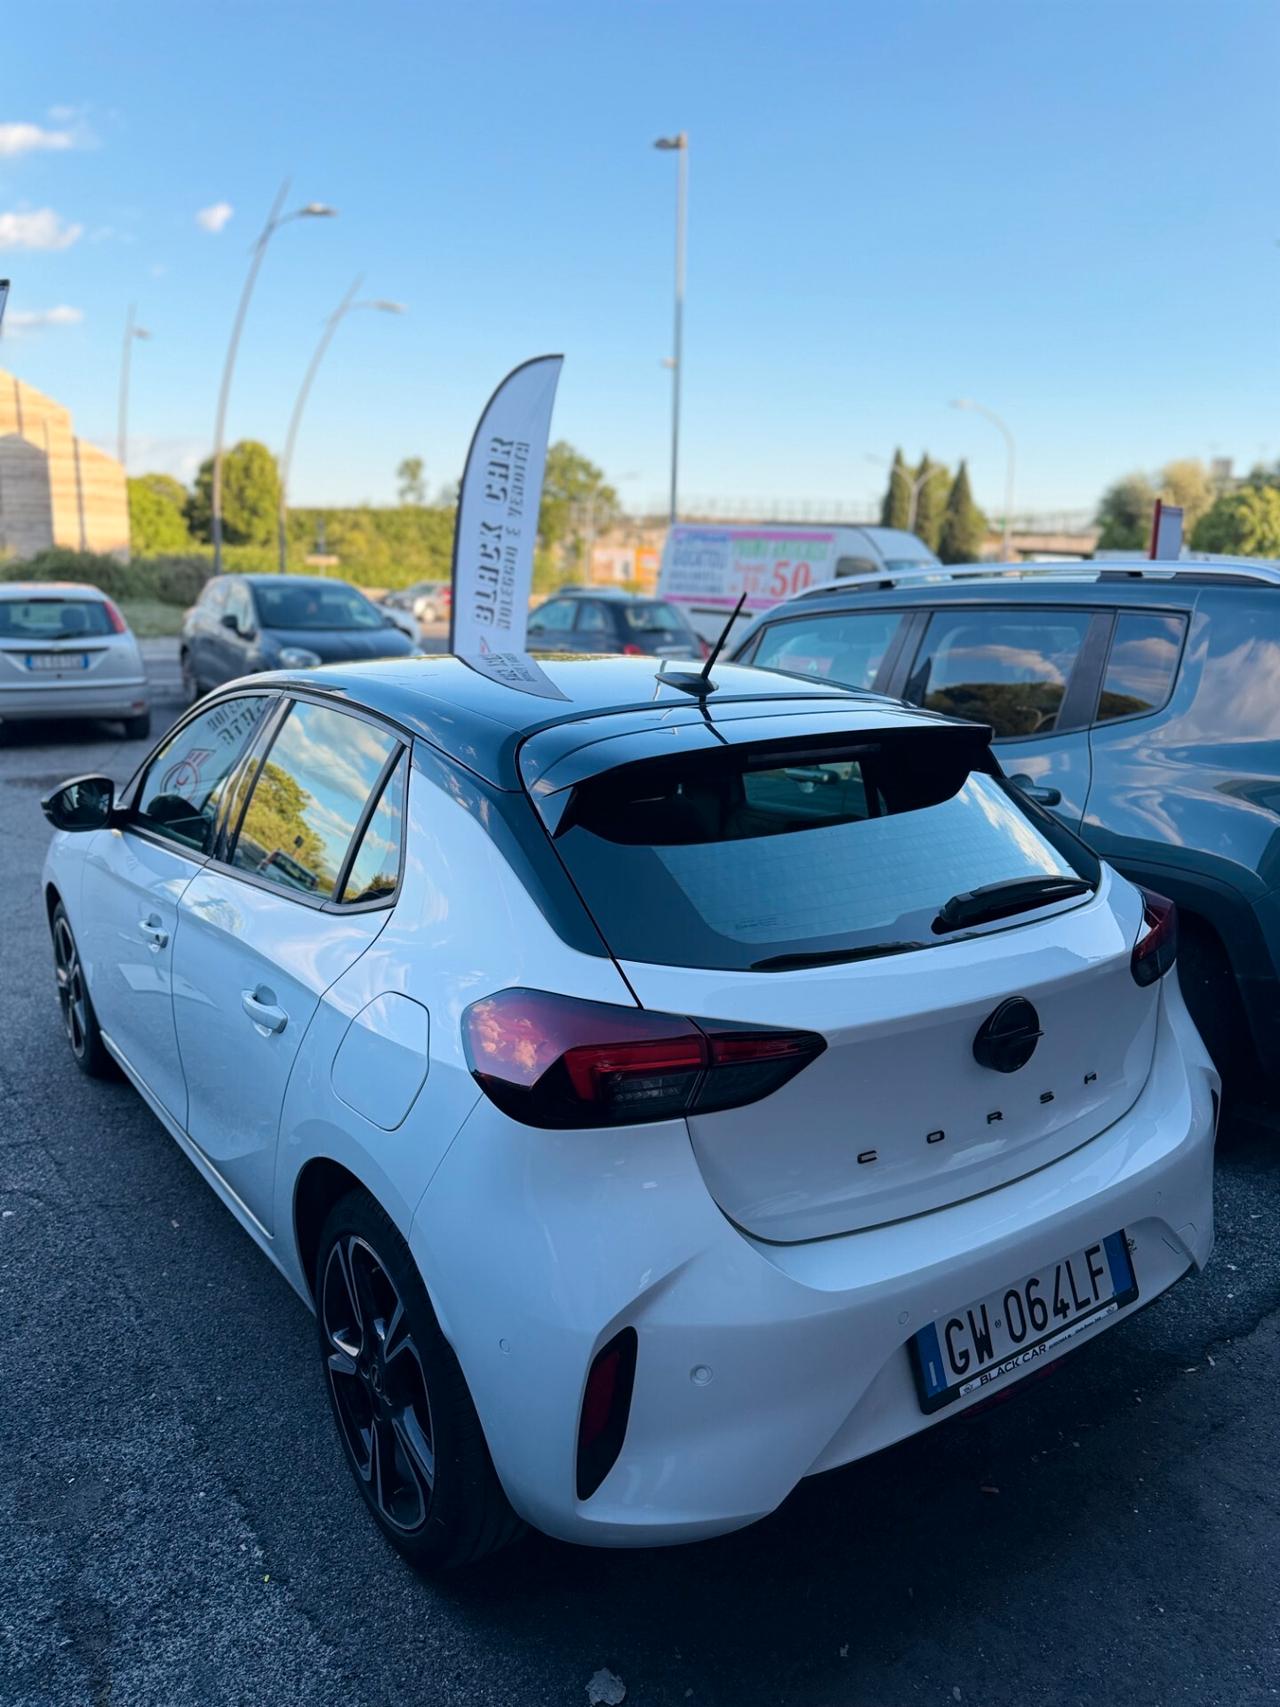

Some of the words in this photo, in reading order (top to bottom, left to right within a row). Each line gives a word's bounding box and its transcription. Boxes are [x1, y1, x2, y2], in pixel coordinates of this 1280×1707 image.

[486, 437, 514, 502] CAR
[476, 521, 503, 626] BLACK
[857, 1072, 1097, 1164] CORSA
[979, 1357, 1020, 1386] BLACK
[1022, 1344, 1047, 1364] CAR
